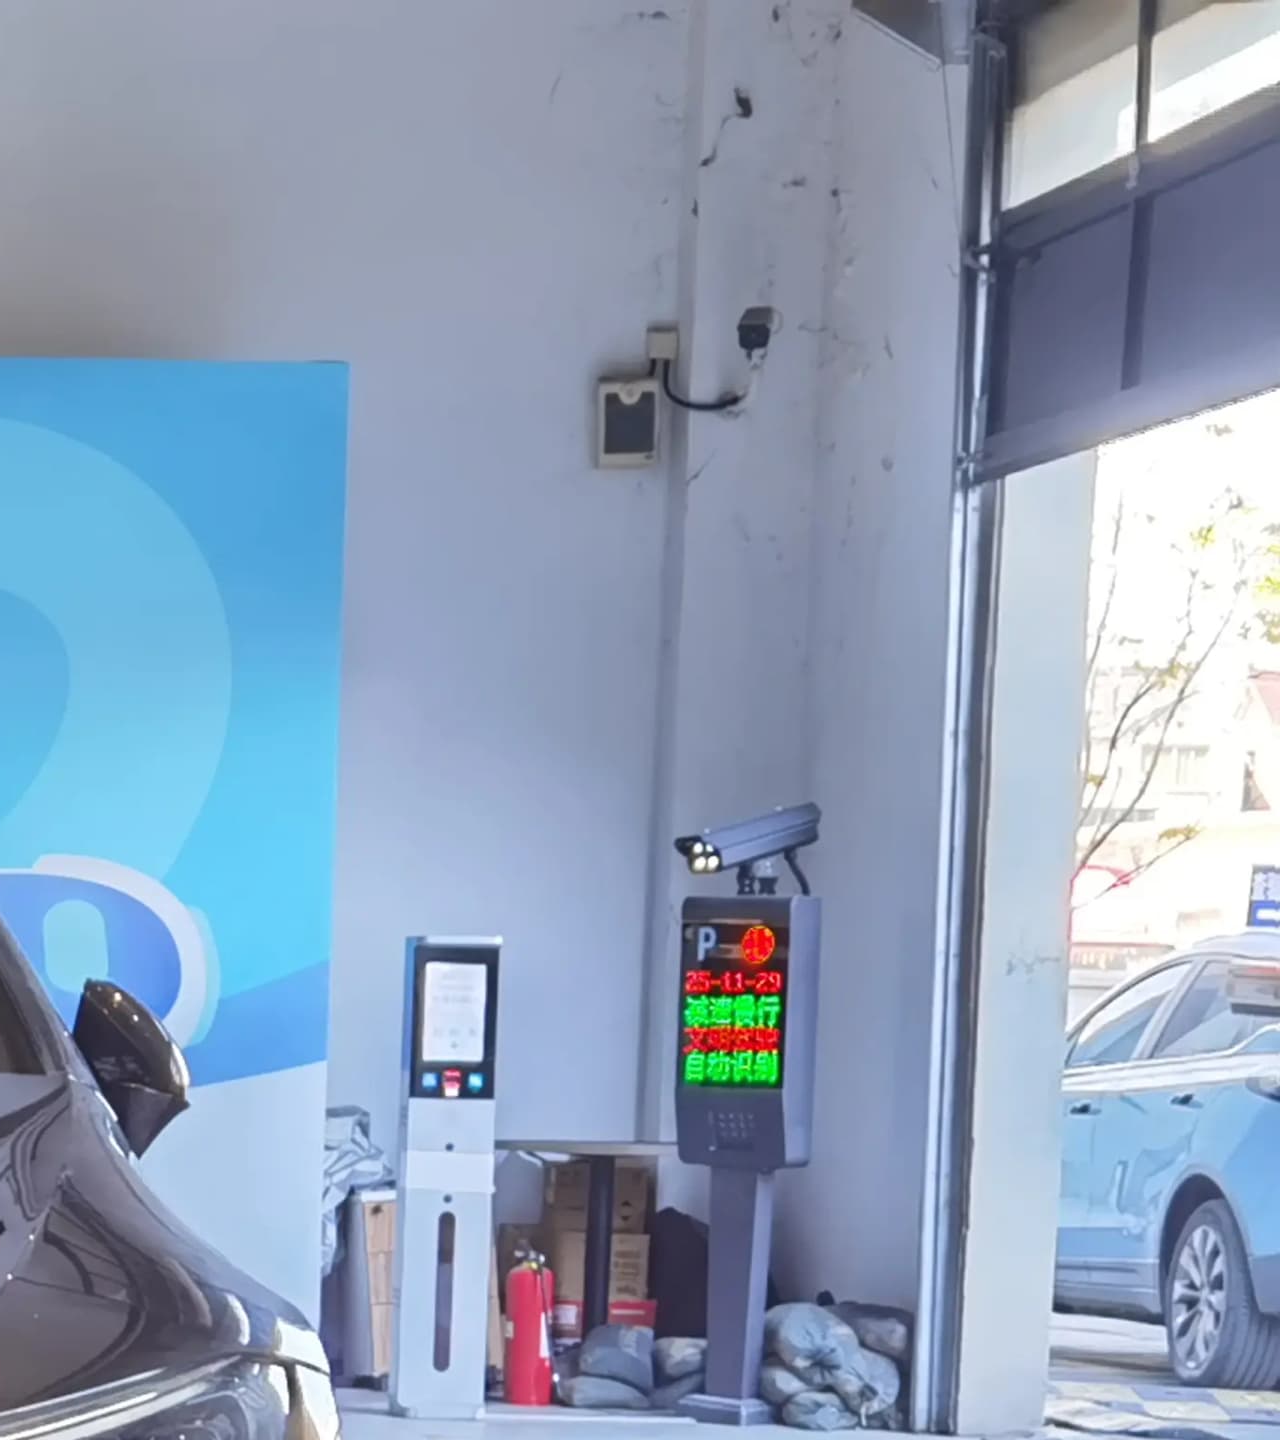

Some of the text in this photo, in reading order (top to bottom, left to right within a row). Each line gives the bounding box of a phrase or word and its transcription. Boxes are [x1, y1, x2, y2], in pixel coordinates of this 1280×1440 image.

[697, 926, 717, 962] P
[684, 970, 782, 994] 25-11-29
[683, 1050, 780, 1083] 自动识别
